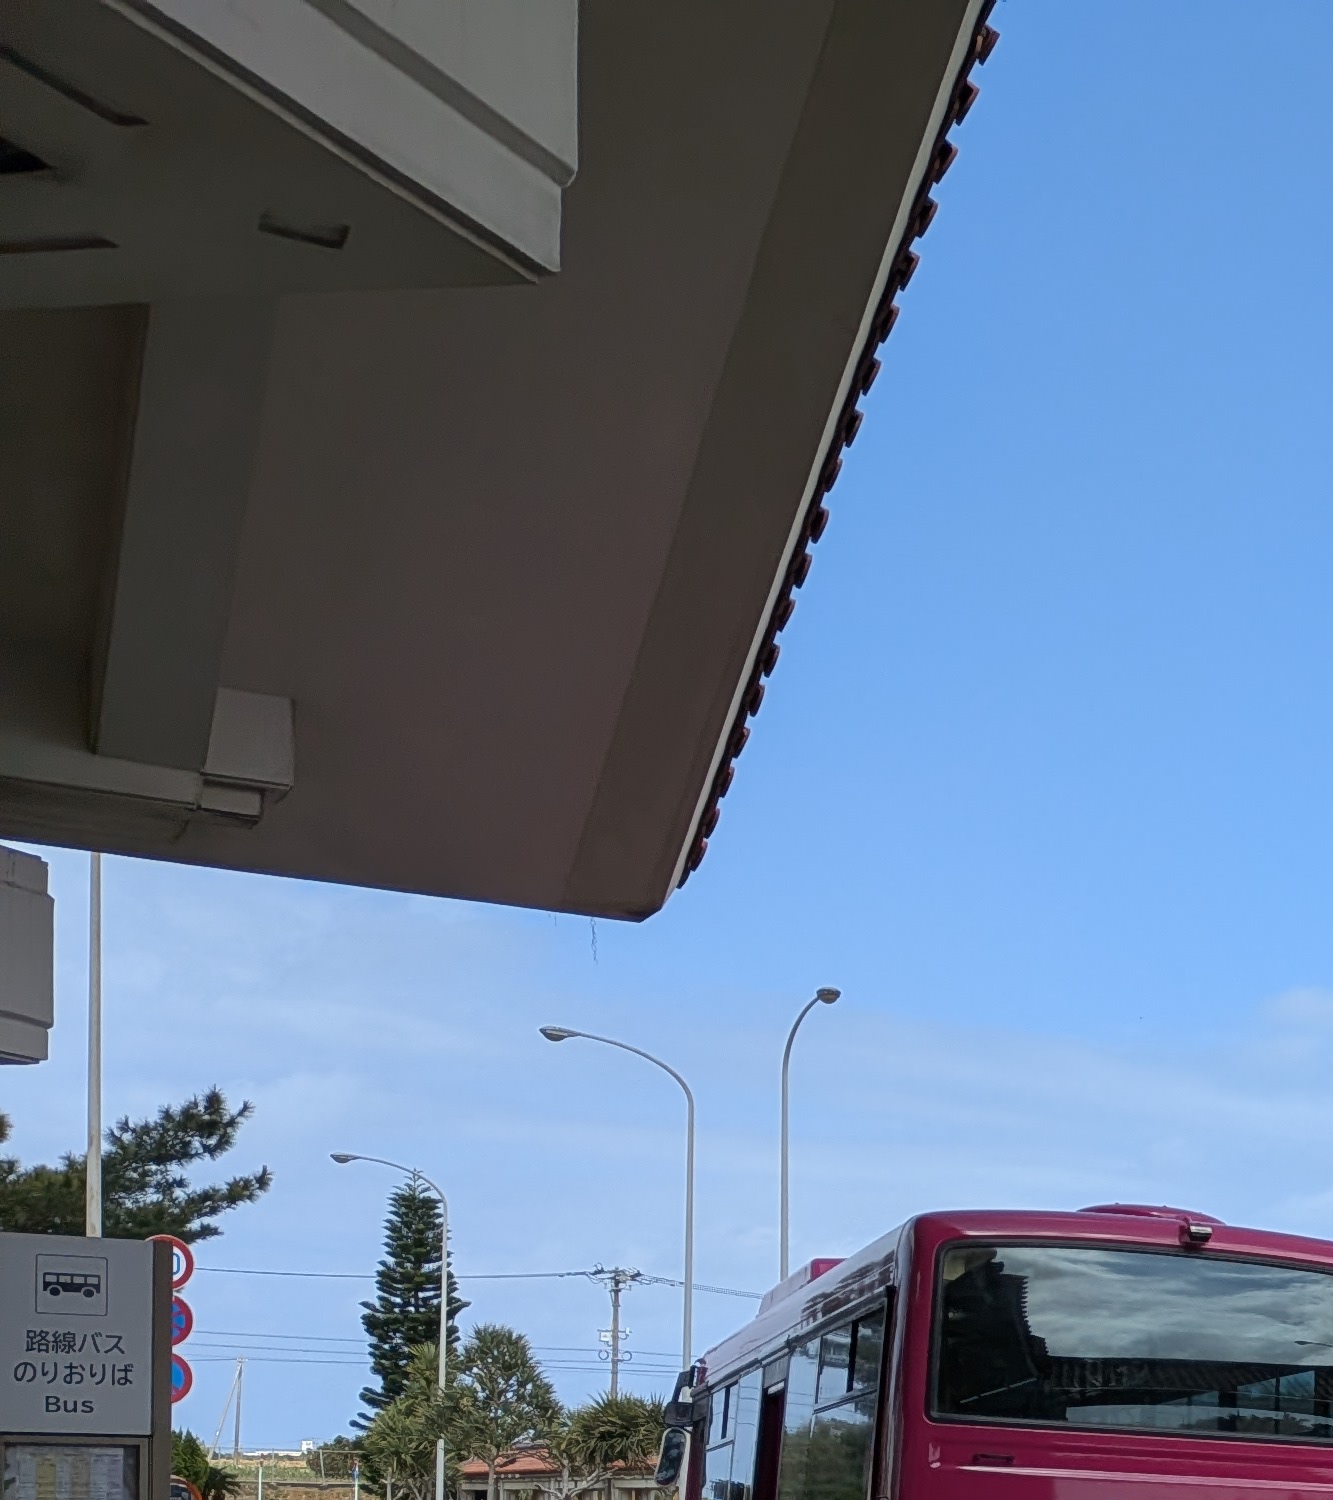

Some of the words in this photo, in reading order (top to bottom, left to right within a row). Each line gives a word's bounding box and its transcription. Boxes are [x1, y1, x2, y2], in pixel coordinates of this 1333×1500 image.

[25, 1329, 126, 1355] 路線バス
[13, 1361, 134, 1386] のりおりば
[45, 1395, 95, 1414] Bus
